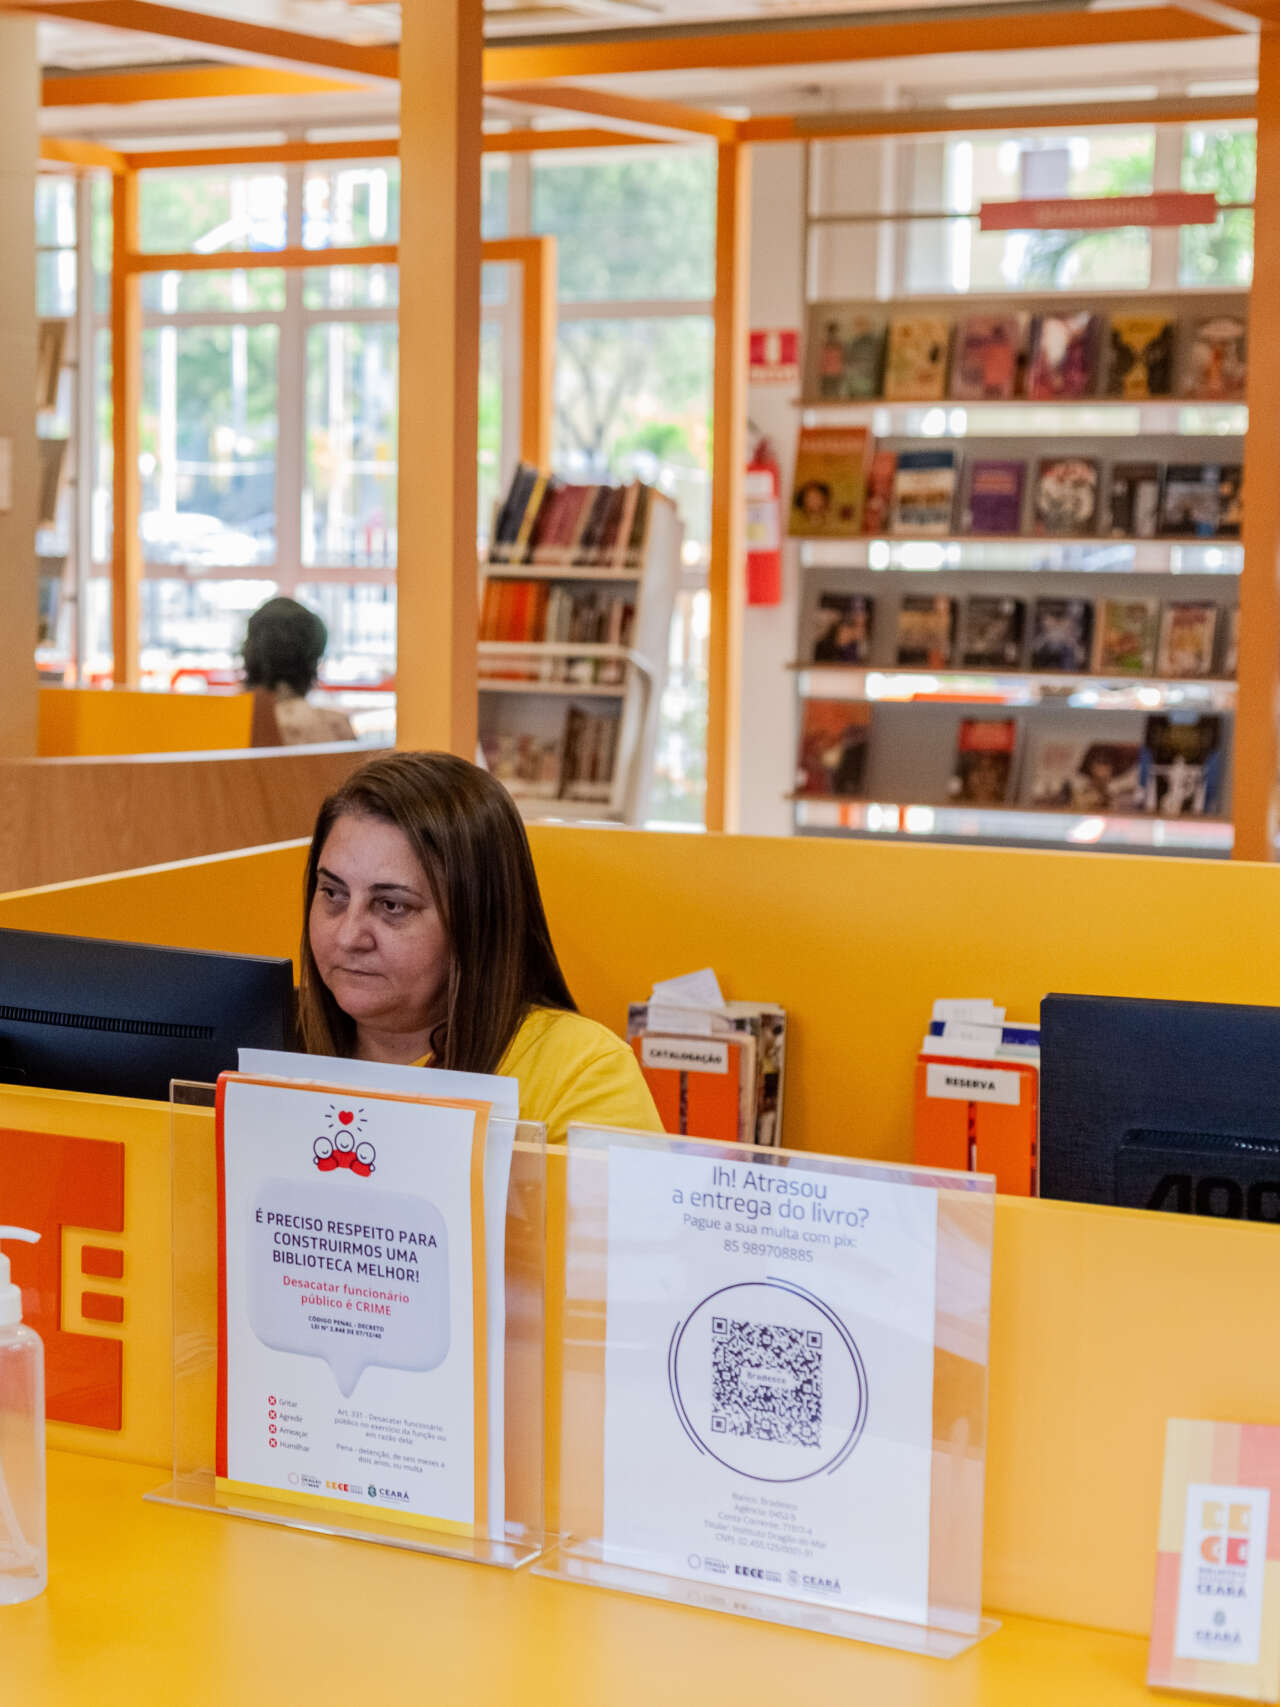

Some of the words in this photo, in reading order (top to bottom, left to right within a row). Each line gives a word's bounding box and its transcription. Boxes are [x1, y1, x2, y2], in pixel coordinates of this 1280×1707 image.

[945, 1077, 995, 1090] RESERVA
[713, 1166, 736, 1188] Ih!
[743, 1171, 828, 1199] Atrasou
[672, 1189, 684, 1204] a
[690, 1191, 772, 1220] entrega
[778, 1199, 805, 1220] do
[812, 1201, 870, 1228] livro?
[255, 1208, 263, 1223] É
[267, 1212, 323, 1231] PRECISO
[327, 1220, 394, 1242] RESPEITO
[399, 1230, 437, 1248] PARA
[683, 1213, 721, 1231] Pague
[724, 1221, 732, 1231] a
[735, 1223, 757, 1234] sua
[761, 1225, 799, 1241] multa
[802, 1231, 830, 1245] com
[274, 1232, 382, 1259] CONSTRUIRMOS
[386, 1249, 418, 1265] UMA
[723, 1240, 739, 1253] 85
[743, 1242, 814, 1263] 989708885
[273, 1250, 352, 1273] BIBLIOTECA
[357, 1262, 420, 1283] MELHOR!
[283, 1275, 339, 1293] Desacatar
[343, 1283, 410, 1304] funcionário
[301, 1293, 343, 1309] público
[346, 1299, 353, 1310] é
[356, 1301, 391, 1316] CRIME
[308, 1313, 332, 1325] CÓDIGO
[333, 1319, 352, 1328] PENAL
[357, 1322, 385, 1333] DECRETO
[369, 1413, 403, 1426] Desacatar
[404, 1419, 443, 1433] funcionário
[379, 1488, 409, 1500] CEARÁ
[802, 1575, 841, 1590] CEARÁ
